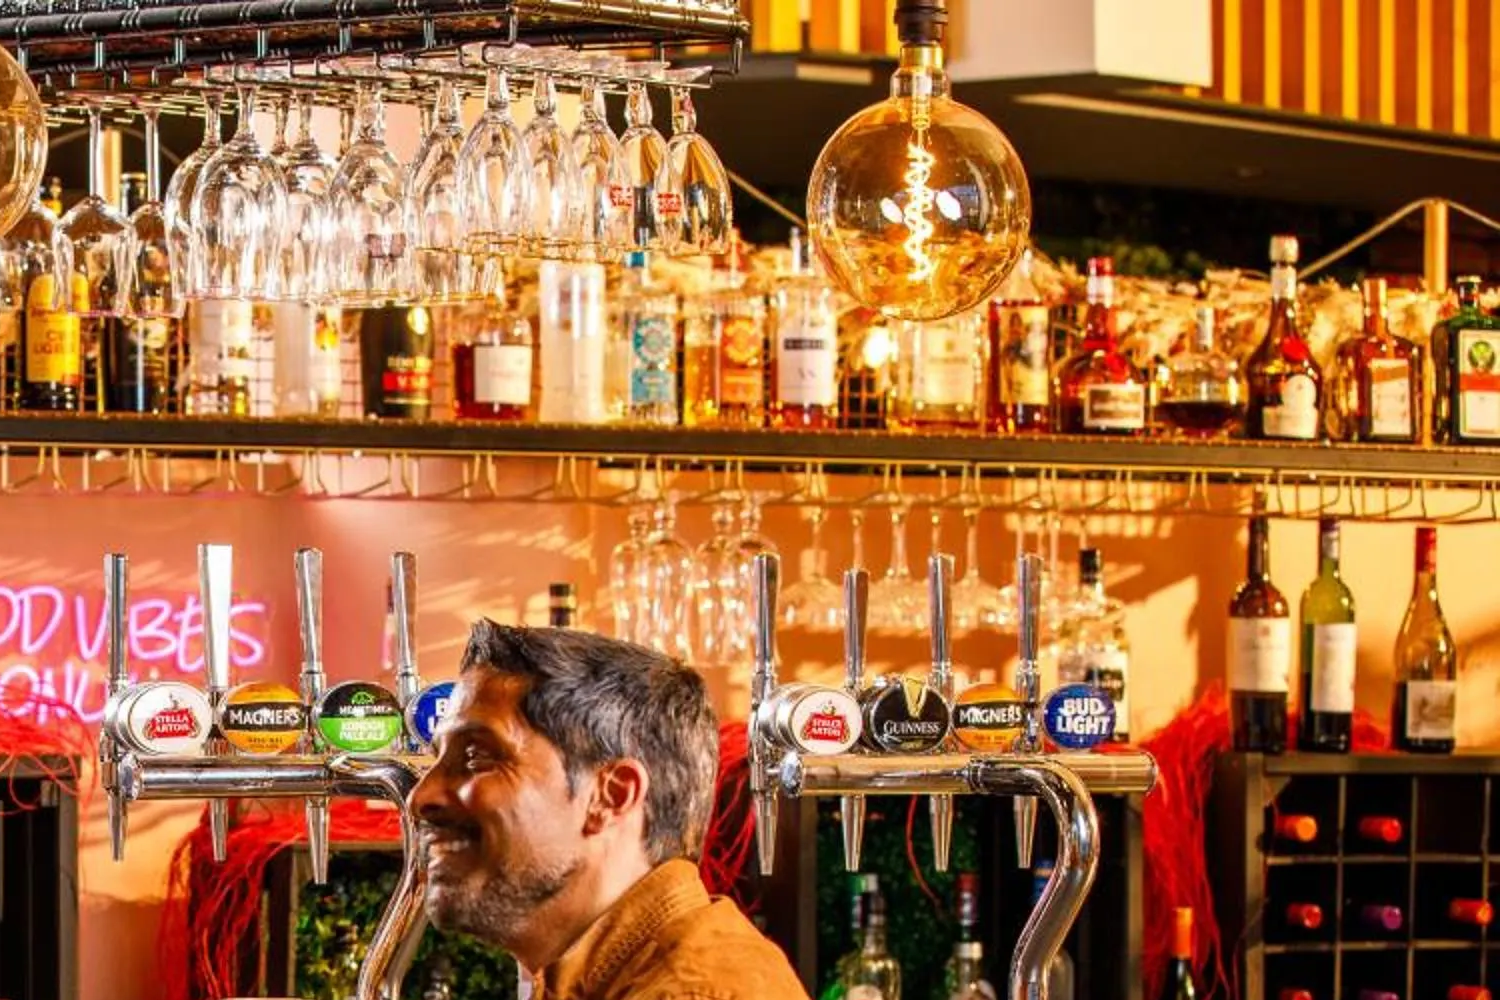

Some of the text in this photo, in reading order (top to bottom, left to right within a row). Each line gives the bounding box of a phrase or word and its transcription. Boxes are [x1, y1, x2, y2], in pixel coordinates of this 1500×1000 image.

[74, 594, 267, 673] VBES
[339, 704, 392, 717] MEATIME
[958, 703, 1023, 725] MAGNERS
[1061, 697, 1105, 715] BUD
[155, 714, 190, 724] STELLA
[229, 706, 300, 727] MAGNERS
[1056, 715, 1111, 735] LIGHT
[883, 719, 941, 735] GUINNESS
